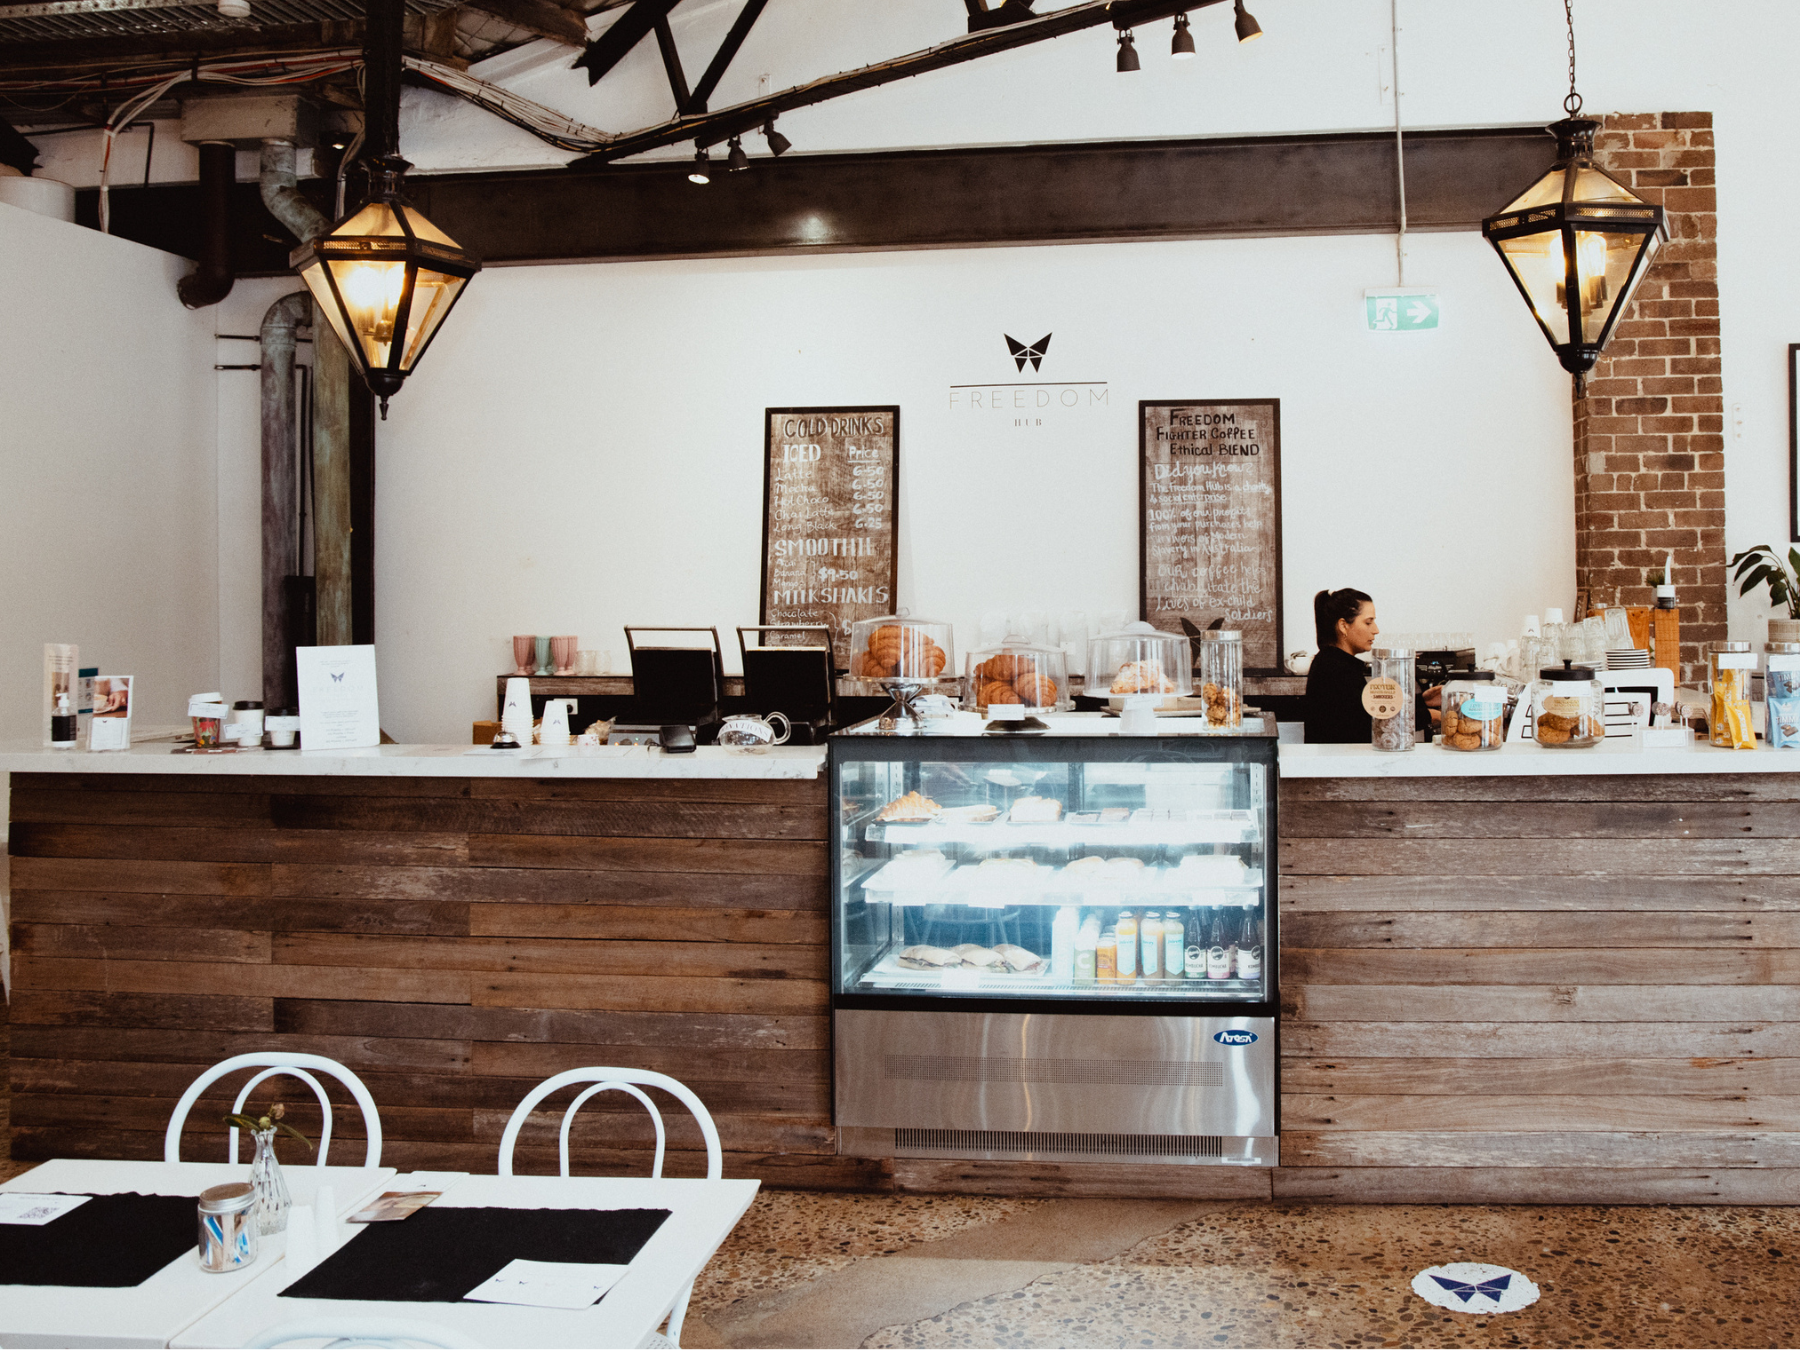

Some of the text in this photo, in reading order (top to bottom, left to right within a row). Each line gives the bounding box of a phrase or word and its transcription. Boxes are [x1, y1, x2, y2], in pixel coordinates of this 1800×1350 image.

[949, 388, 1109, 410] FREEDOM
[1014, 418, 1042, 427] HUB
[1170, 408, 1236, 426] FREEDOM
[784, 416, 884, 438] COLD DRINKS
[1156, 427, 1207, 441] FIGHTER
[783, 444, 880, 462] ICED Price
[1170, 443, 1213, 456] Ethical
[775, 466, 884, 481] Latte 6.50
[1155, 461, 1184, 480] Did
[1183, 464, 1212, 484] you
[774, 479, 884, 494] Mocha 6.50
[1150, 482, 1169, 493] The
[774, 491, 884, 507] Hot Choco 6.50
[775, 503, 884, 521] Chai Latte 6.50
[1149, 508, 1176, 521] 100%
[1180, 509, 1193, 520] of
[773, 518, 882, 535] Long Black 6.25
[1149, 522, 1170, 532] from
[1171, 522, 1191, 534] your
[774, 537, 878, 557] SMOOTHIE
[774, 566, 859, 582] Banana $9.50
[1192, 564, 1237, 580] coffee
[770, 608, 818, 618] Chocolate
[769, 630, 806, 640] Caramel
